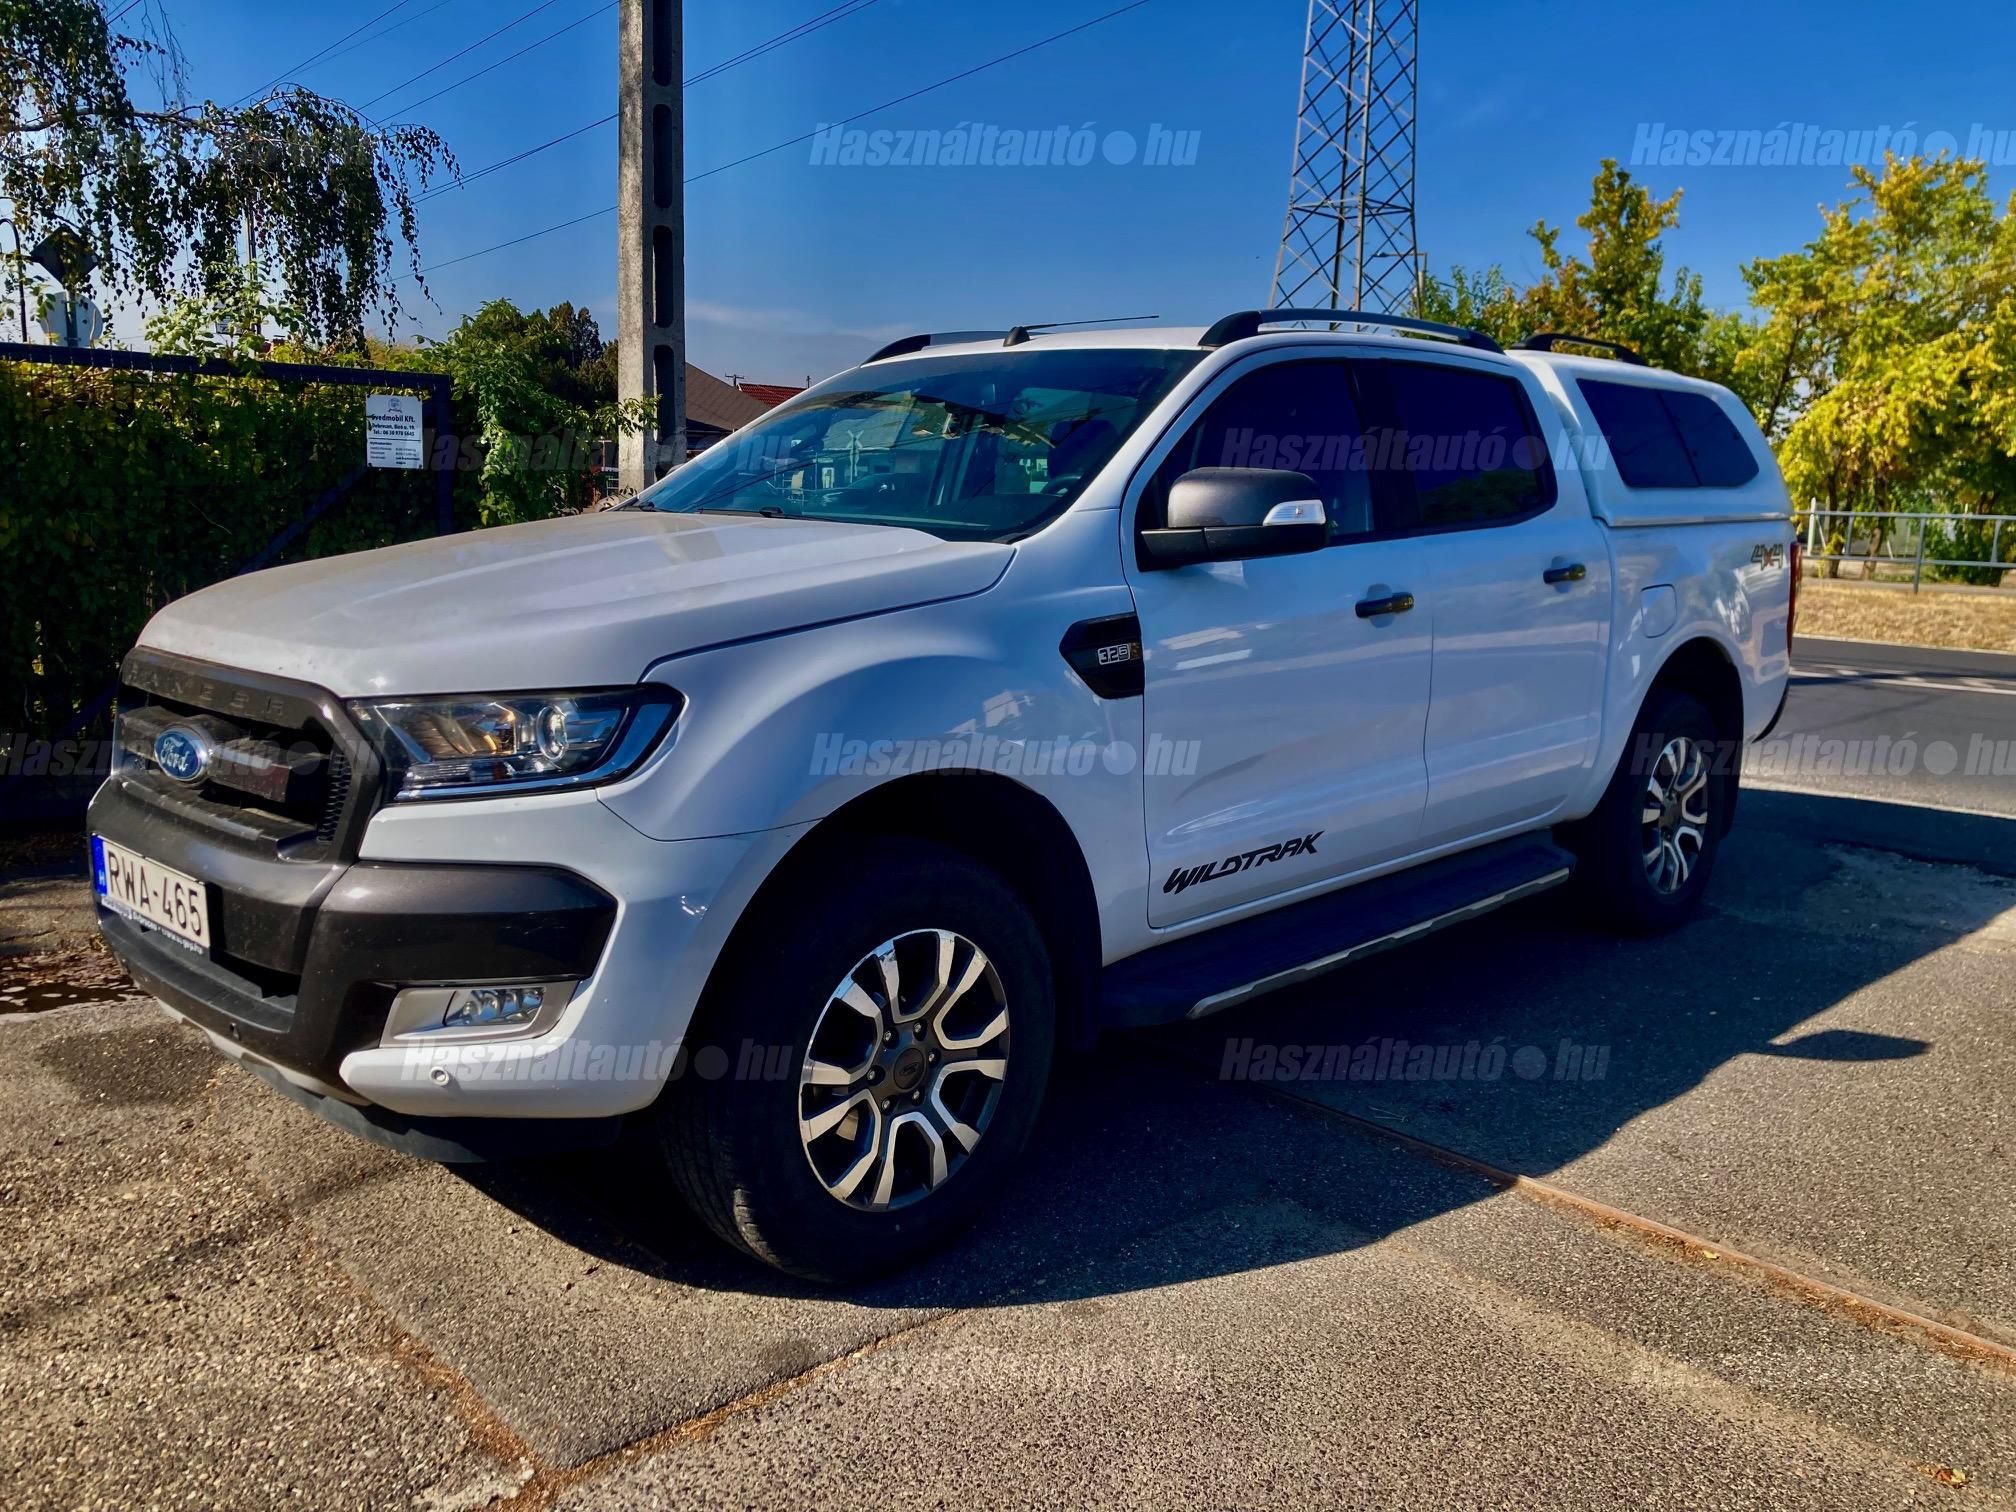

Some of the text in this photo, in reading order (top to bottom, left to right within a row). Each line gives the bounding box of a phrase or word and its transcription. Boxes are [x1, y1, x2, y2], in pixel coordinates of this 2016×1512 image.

[161, 736, 190, 772] Ford
[108, 850, 202, 937] RWA-465
[1163, 830, 1325, 895] WILDTRAK
